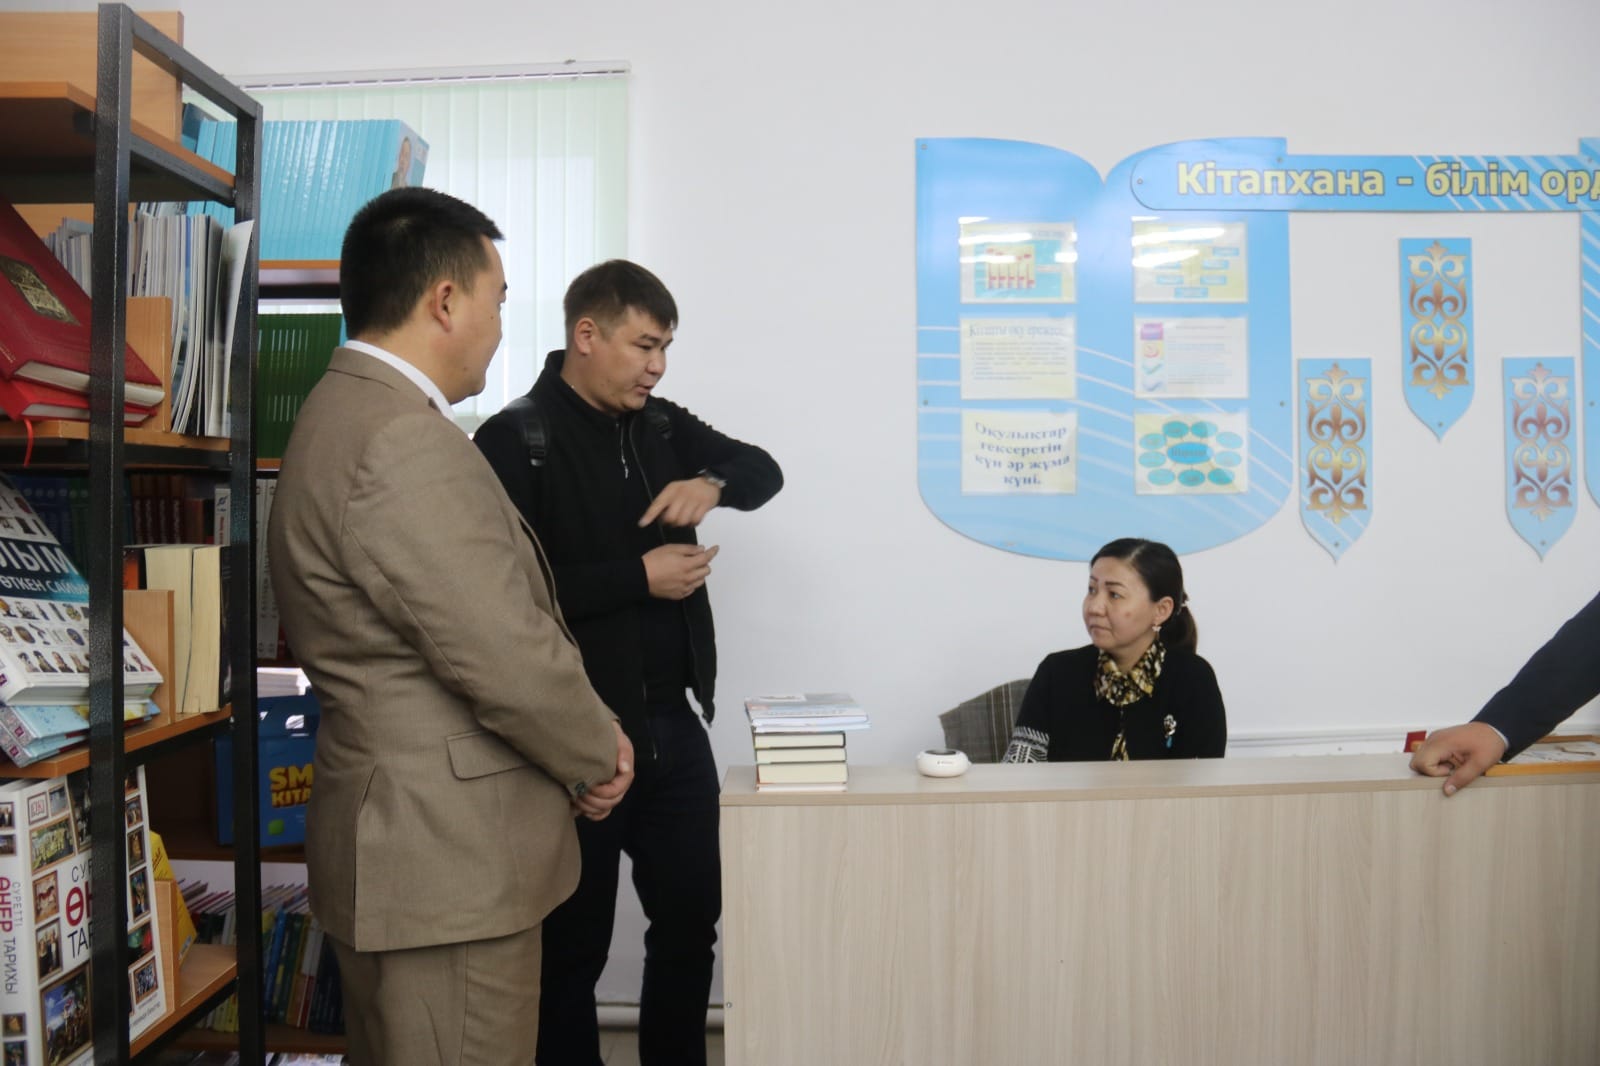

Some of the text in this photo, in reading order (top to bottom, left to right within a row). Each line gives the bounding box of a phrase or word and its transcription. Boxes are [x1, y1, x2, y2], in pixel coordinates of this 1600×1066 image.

[1176, 161, 1384, 196] Кітапхана
[1424, 161, 1529, 196] білім
[4, 936, 18, 995] ТАРИХЫ
